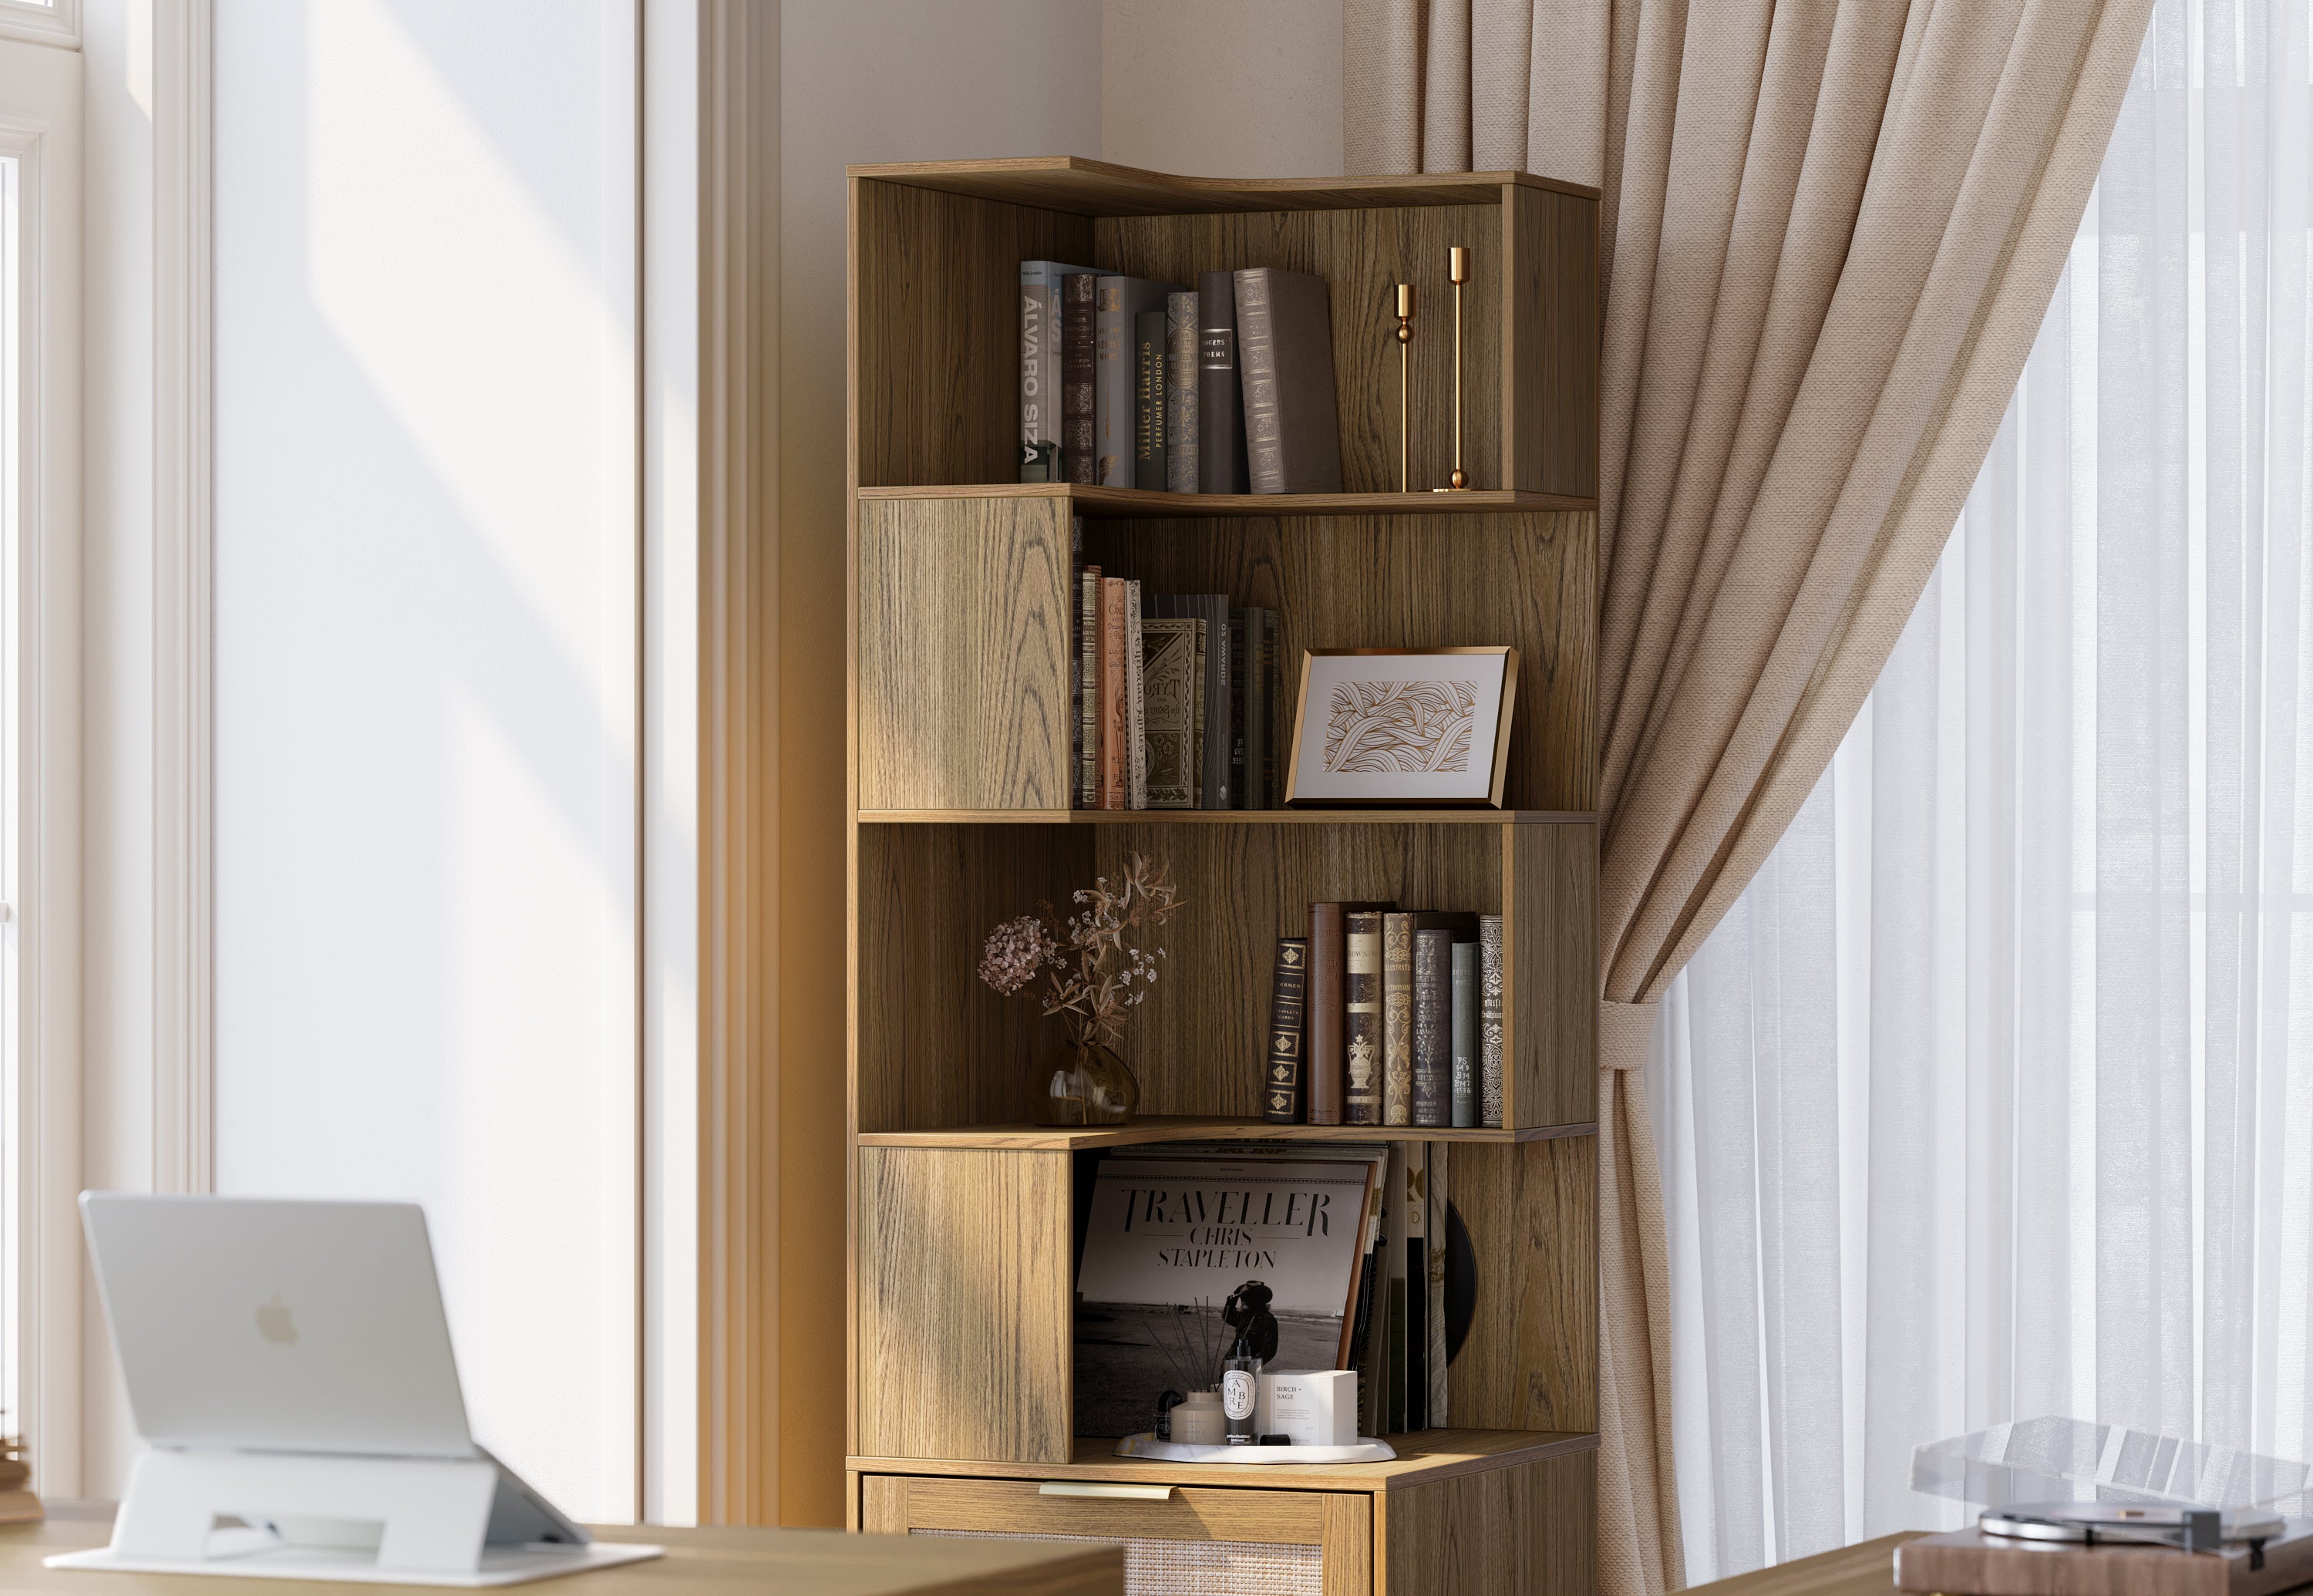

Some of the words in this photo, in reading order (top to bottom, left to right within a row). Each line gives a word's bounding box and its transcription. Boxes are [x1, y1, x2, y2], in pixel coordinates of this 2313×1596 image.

[1024, 296, 1042, 396] ÁLVARO
[1139, 342, 1150, 399] Harris
[1024, 404, 1039, 465] SIZA
[1139, 407, 1150, 461] Miller
[1121, 1189, 1331, 1237] TRAVELLER
[1190, 1227, 1252, 1245] CHRIS
[1157, 1248, 1276, 1269] STAPLETON
